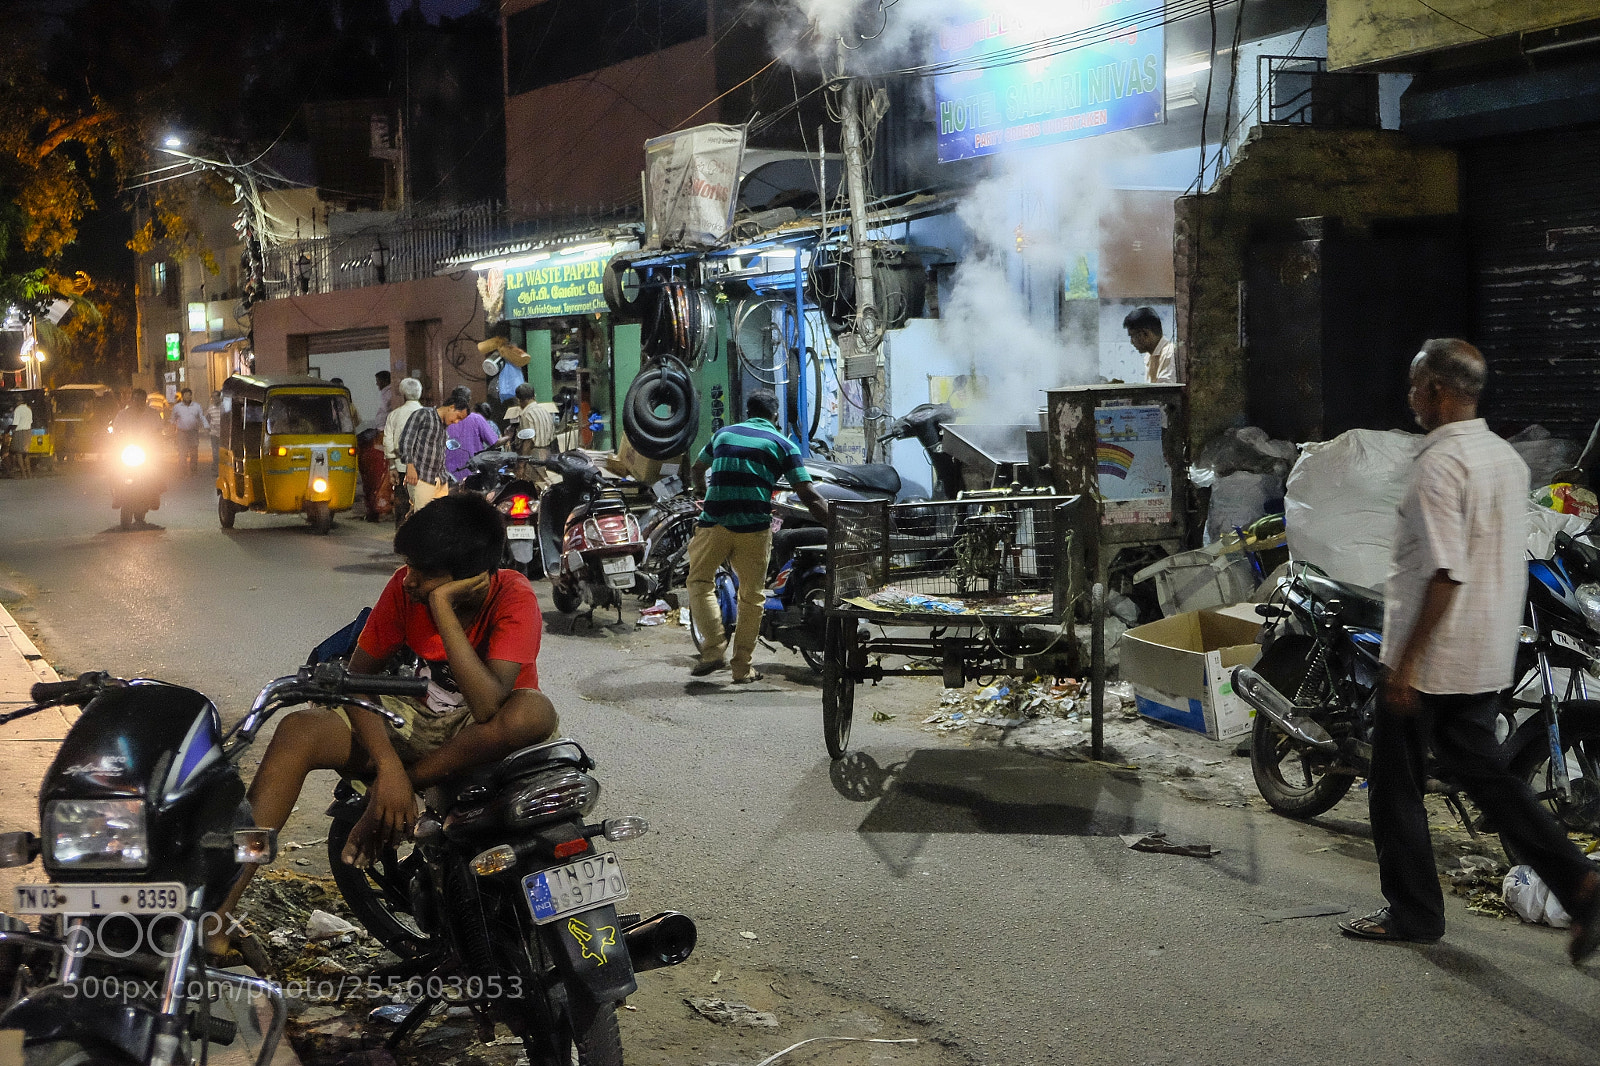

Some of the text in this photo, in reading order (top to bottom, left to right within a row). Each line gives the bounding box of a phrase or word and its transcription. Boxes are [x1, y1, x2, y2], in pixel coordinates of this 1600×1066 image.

[940, 53, 1158, 135] HOTEL SABARI NIVAS
[975, 129, 1003, 149] PARTY
[1042, 109, 1108, 135] UNDERTAKEN
[506, 273, 524, 290] R.P.
[525, 266, 562, 287] WASTE
[563, 260, 600, 282] PAPER
[552, 856, 605, 889] TN 07
[18, 889, 178, 908] TN 03 L 8359
